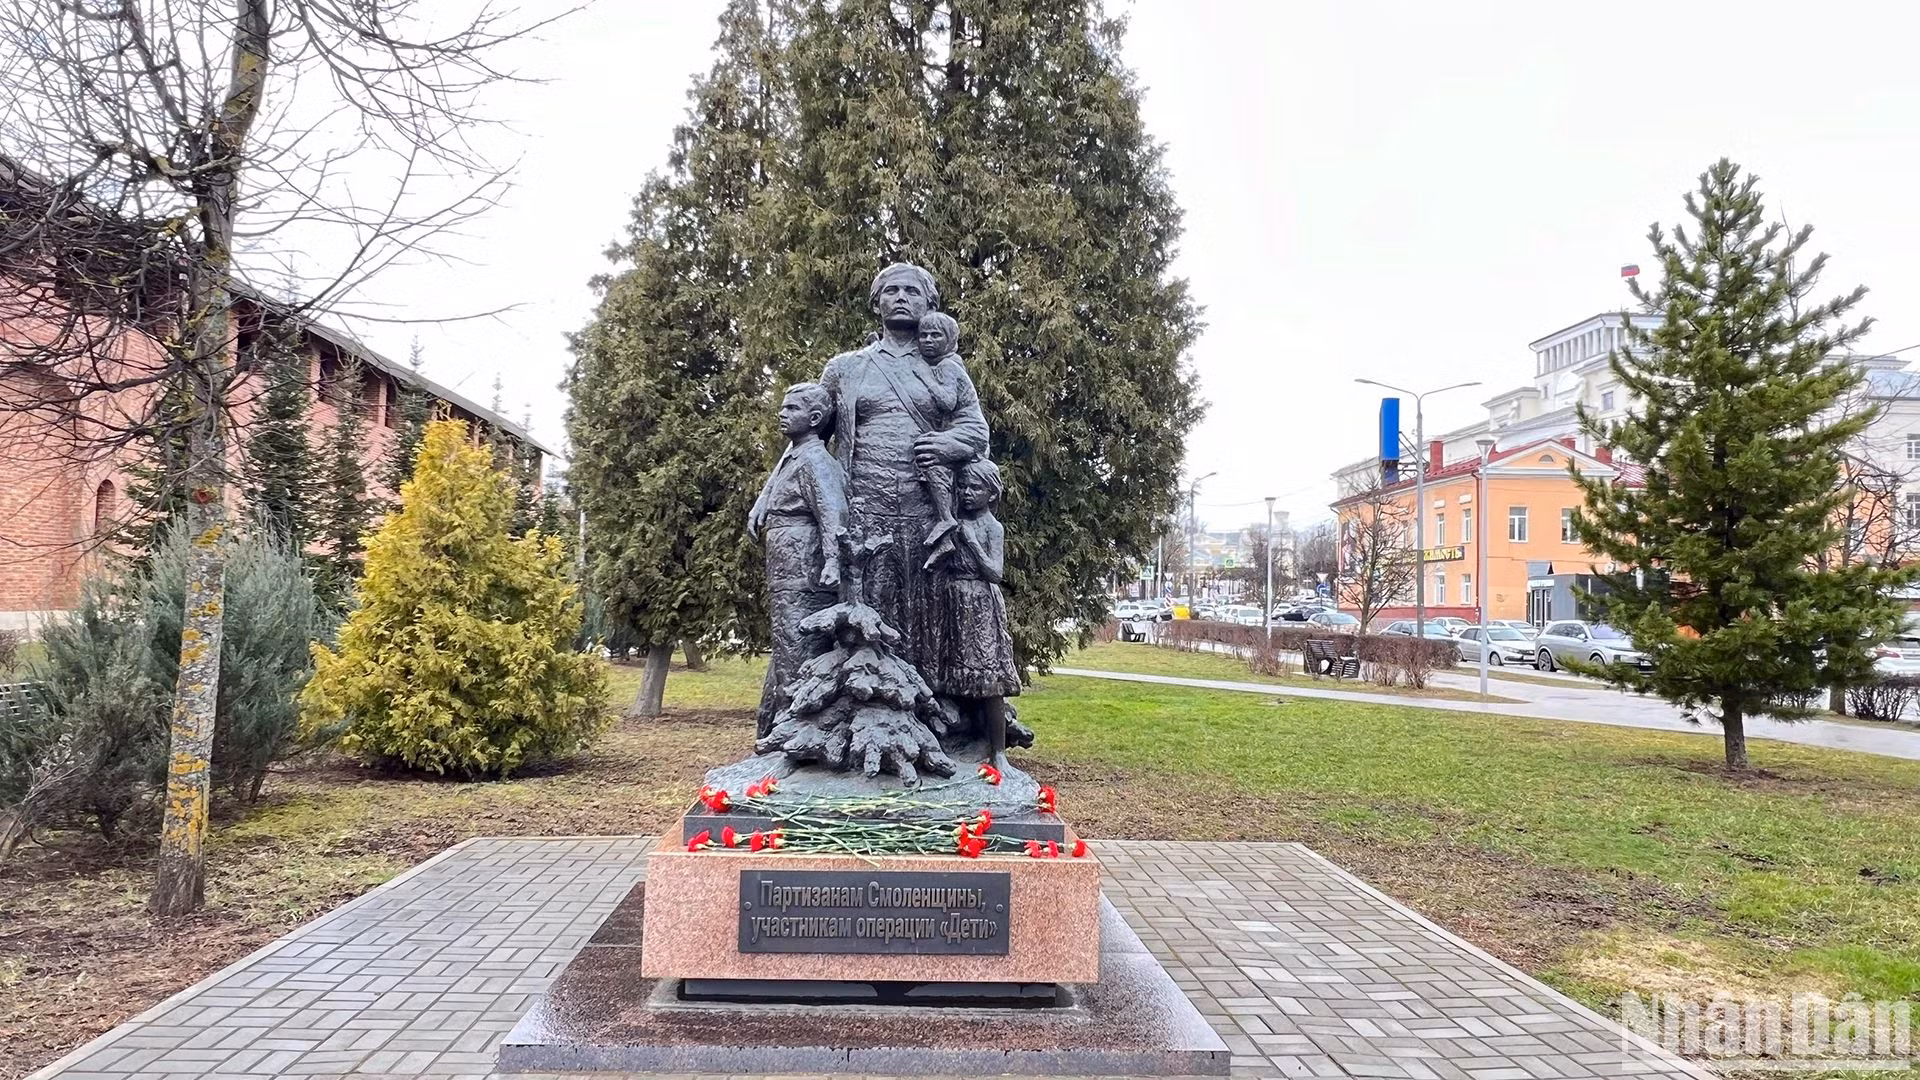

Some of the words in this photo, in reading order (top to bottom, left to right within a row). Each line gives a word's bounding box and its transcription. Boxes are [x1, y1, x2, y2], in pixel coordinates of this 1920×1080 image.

[760, 880, 863, 912] Партизанам
[867, 881, 986, 913] Смоленщины,
[751, 915, 852, 943] участникам
[855, 916, 935, 944] операции
[940, 912, 998, 944] «Дети»
